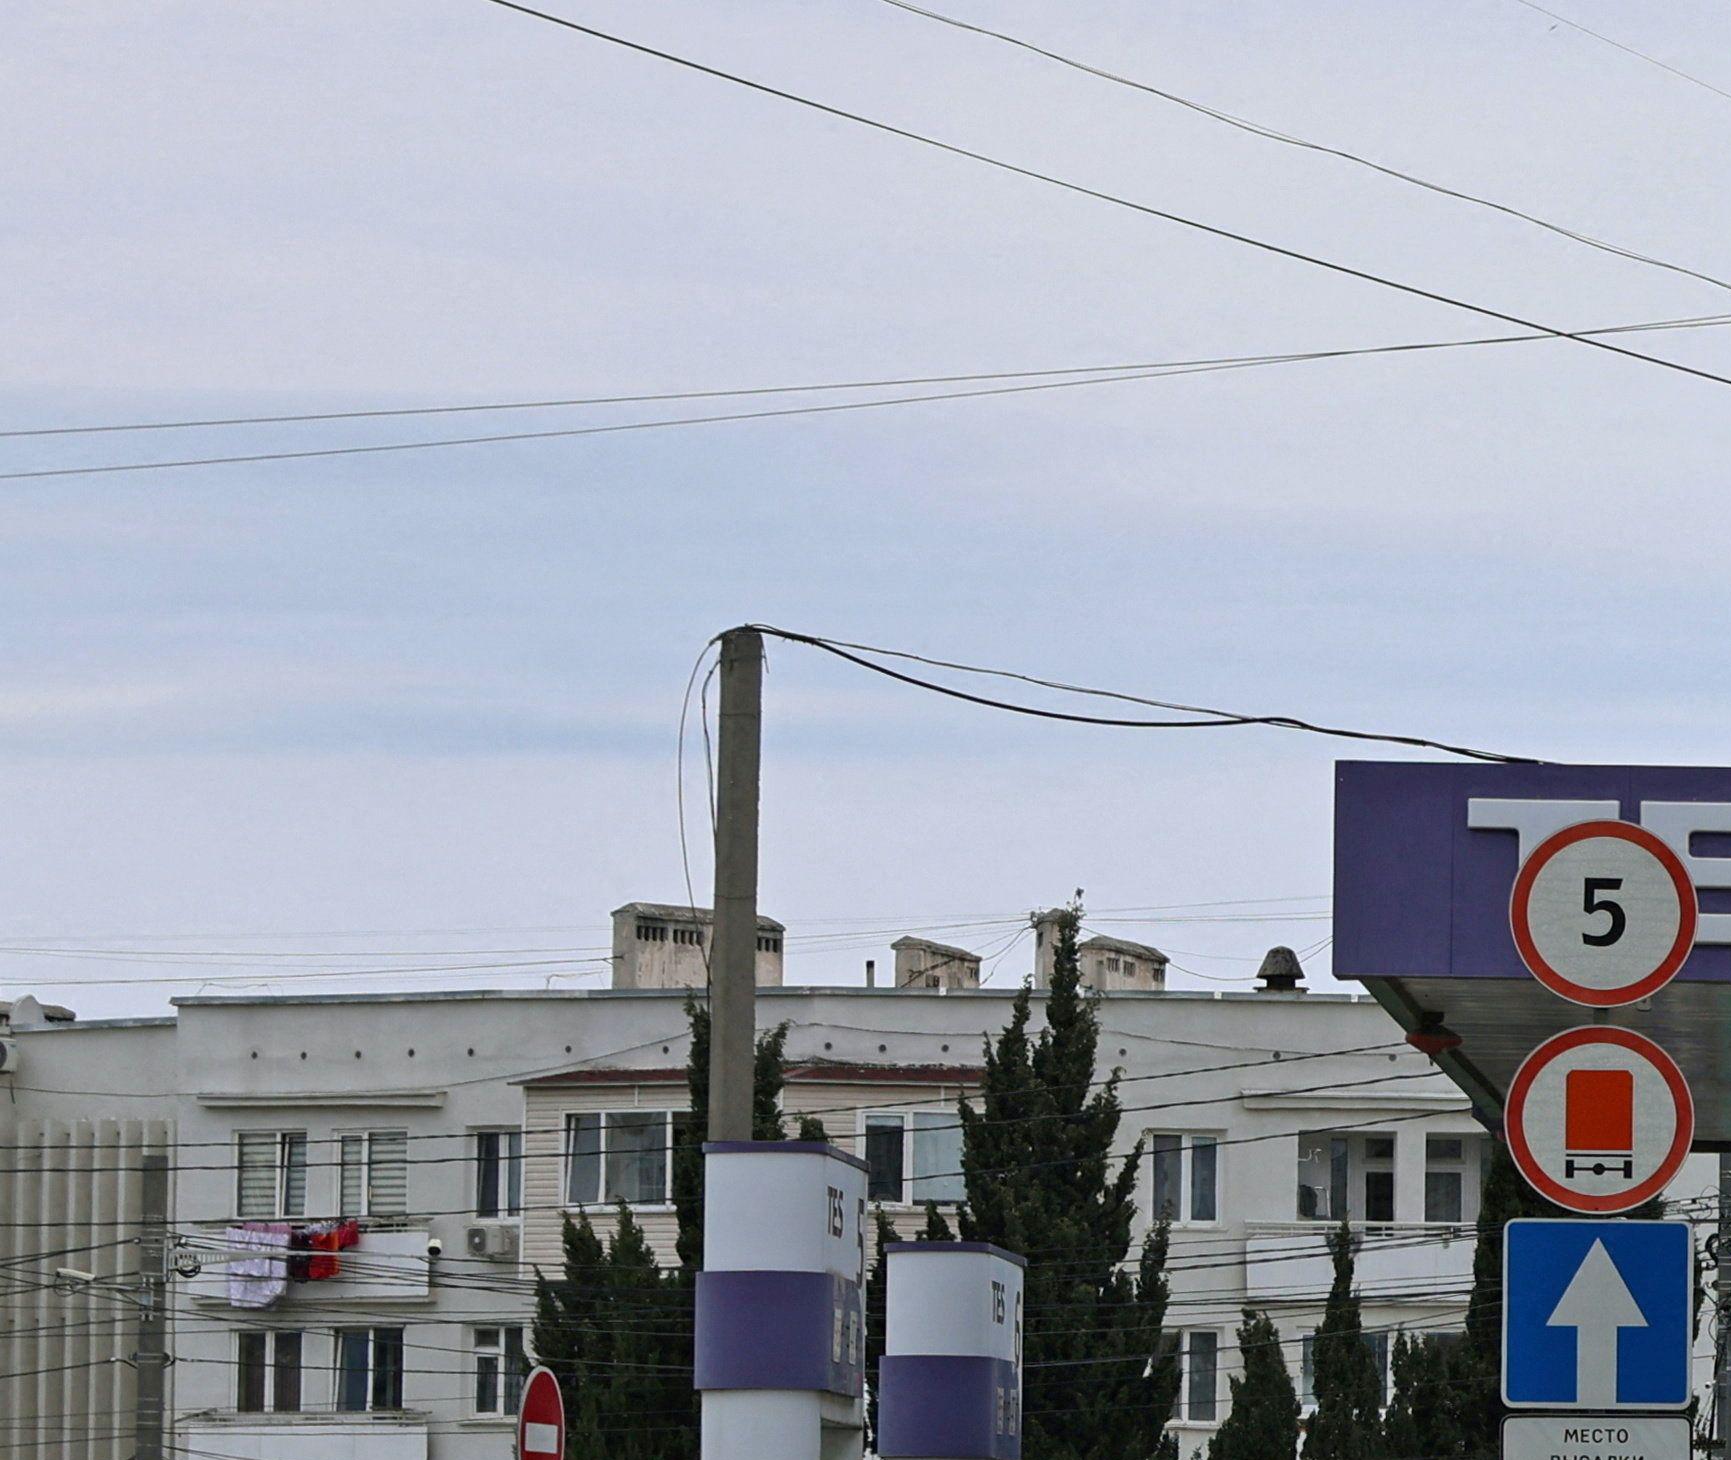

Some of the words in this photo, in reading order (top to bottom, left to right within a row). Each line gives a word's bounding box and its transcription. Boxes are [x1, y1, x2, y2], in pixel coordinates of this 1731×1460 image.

[1581, 877, 1627, 947] 5
[827, 1185, 844, 1239] TES
[991, 1280, 1005, 1325] TES
[1564, 1429, 1629, 1443] МЕСТО
